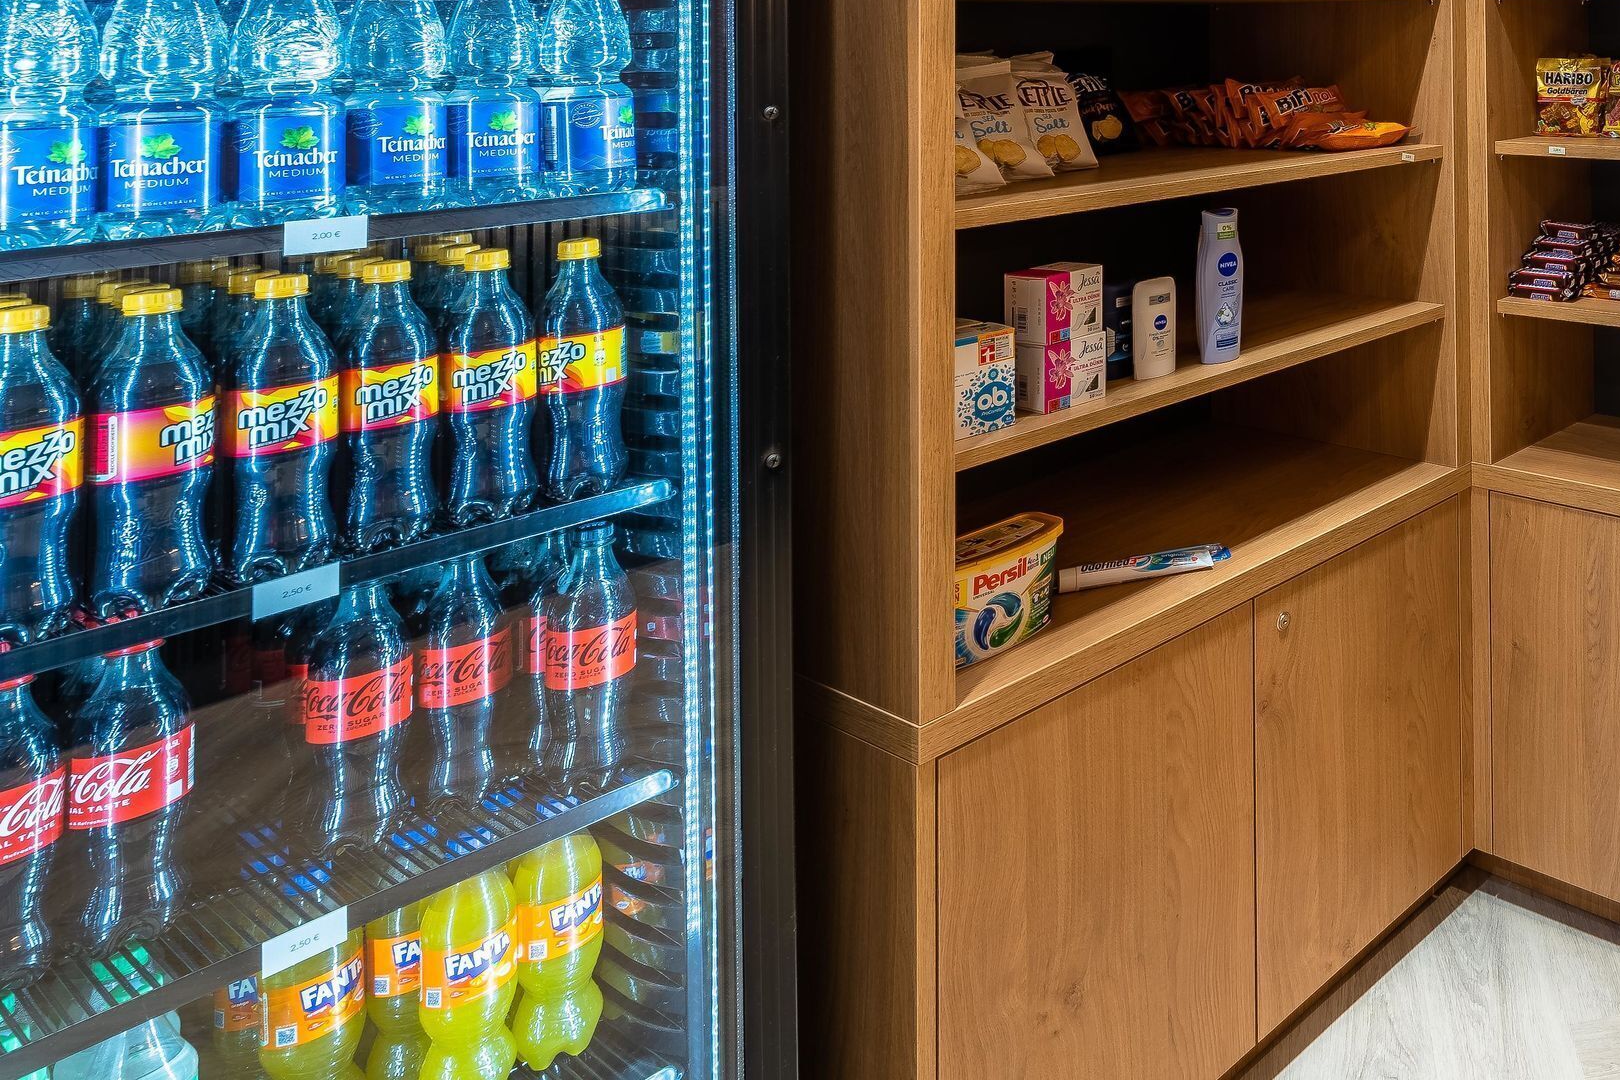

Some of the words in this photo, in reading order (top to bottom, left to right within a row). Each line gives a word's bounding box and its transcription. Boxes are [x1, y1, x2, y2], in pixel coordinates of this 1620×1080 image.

[1545, 71, 1594, 86] HARIBO
[1546, 87, 1588, 96] Goldbären
[970, 119, 1013, 138] Salt
[1033, 117, 1071, 134] Salt
[376, 134, 446, 153] Teinacher
[466, 130, 536, 148] Teinacher
[253, 146, 338, 168] Teinacher
[392, 153, 440, 163] MEDIUM
[478, 147, 527, 158] MEDIUM
[11, 162, 99, 186] Teinacher
[110, 156, 207, 179] Teinacher
[268, 167, 327, 179] MEDIUM
[32, 184, 92, 197] MEDIUM
[123, 177, 190, 190] MEDIUM
[333, 230, 341, 238] €
[1219, 261, 1237, 269] NIVEA
[1072, 296, 1088, 304] ULTRA
[538, 340, 587, 369] ezzo
[453, 349, 527, 388] mezzo
[1073, 363, 1089, 371] ULTRA
[354, 363, 435, 405] mezzo
[462, 369, 515, 404] mix
[237, 385, 328, 429] mezzo
[365, 384, 421, 422] mix
[976, 386, 1010, 411] o.b.
[160, 410, 216, 448] mez
[249, 407, 313, 446] mix
[0, 428, 76, 471] ezzo
[973, 555, 1028, 596] Persil
[305, 583, 313, 592] €
[580, 665, 607, 676] SUGA
[306, 664, 410, 720] Coca-Cola
[87, 798, 131, 814] TASTE
[18, 820, 56, 841] TASTE
[313, 932, 321, 941] €
[446, 931, 511, 977] FANTA
[301, 957, 363, 1010] FANTA
